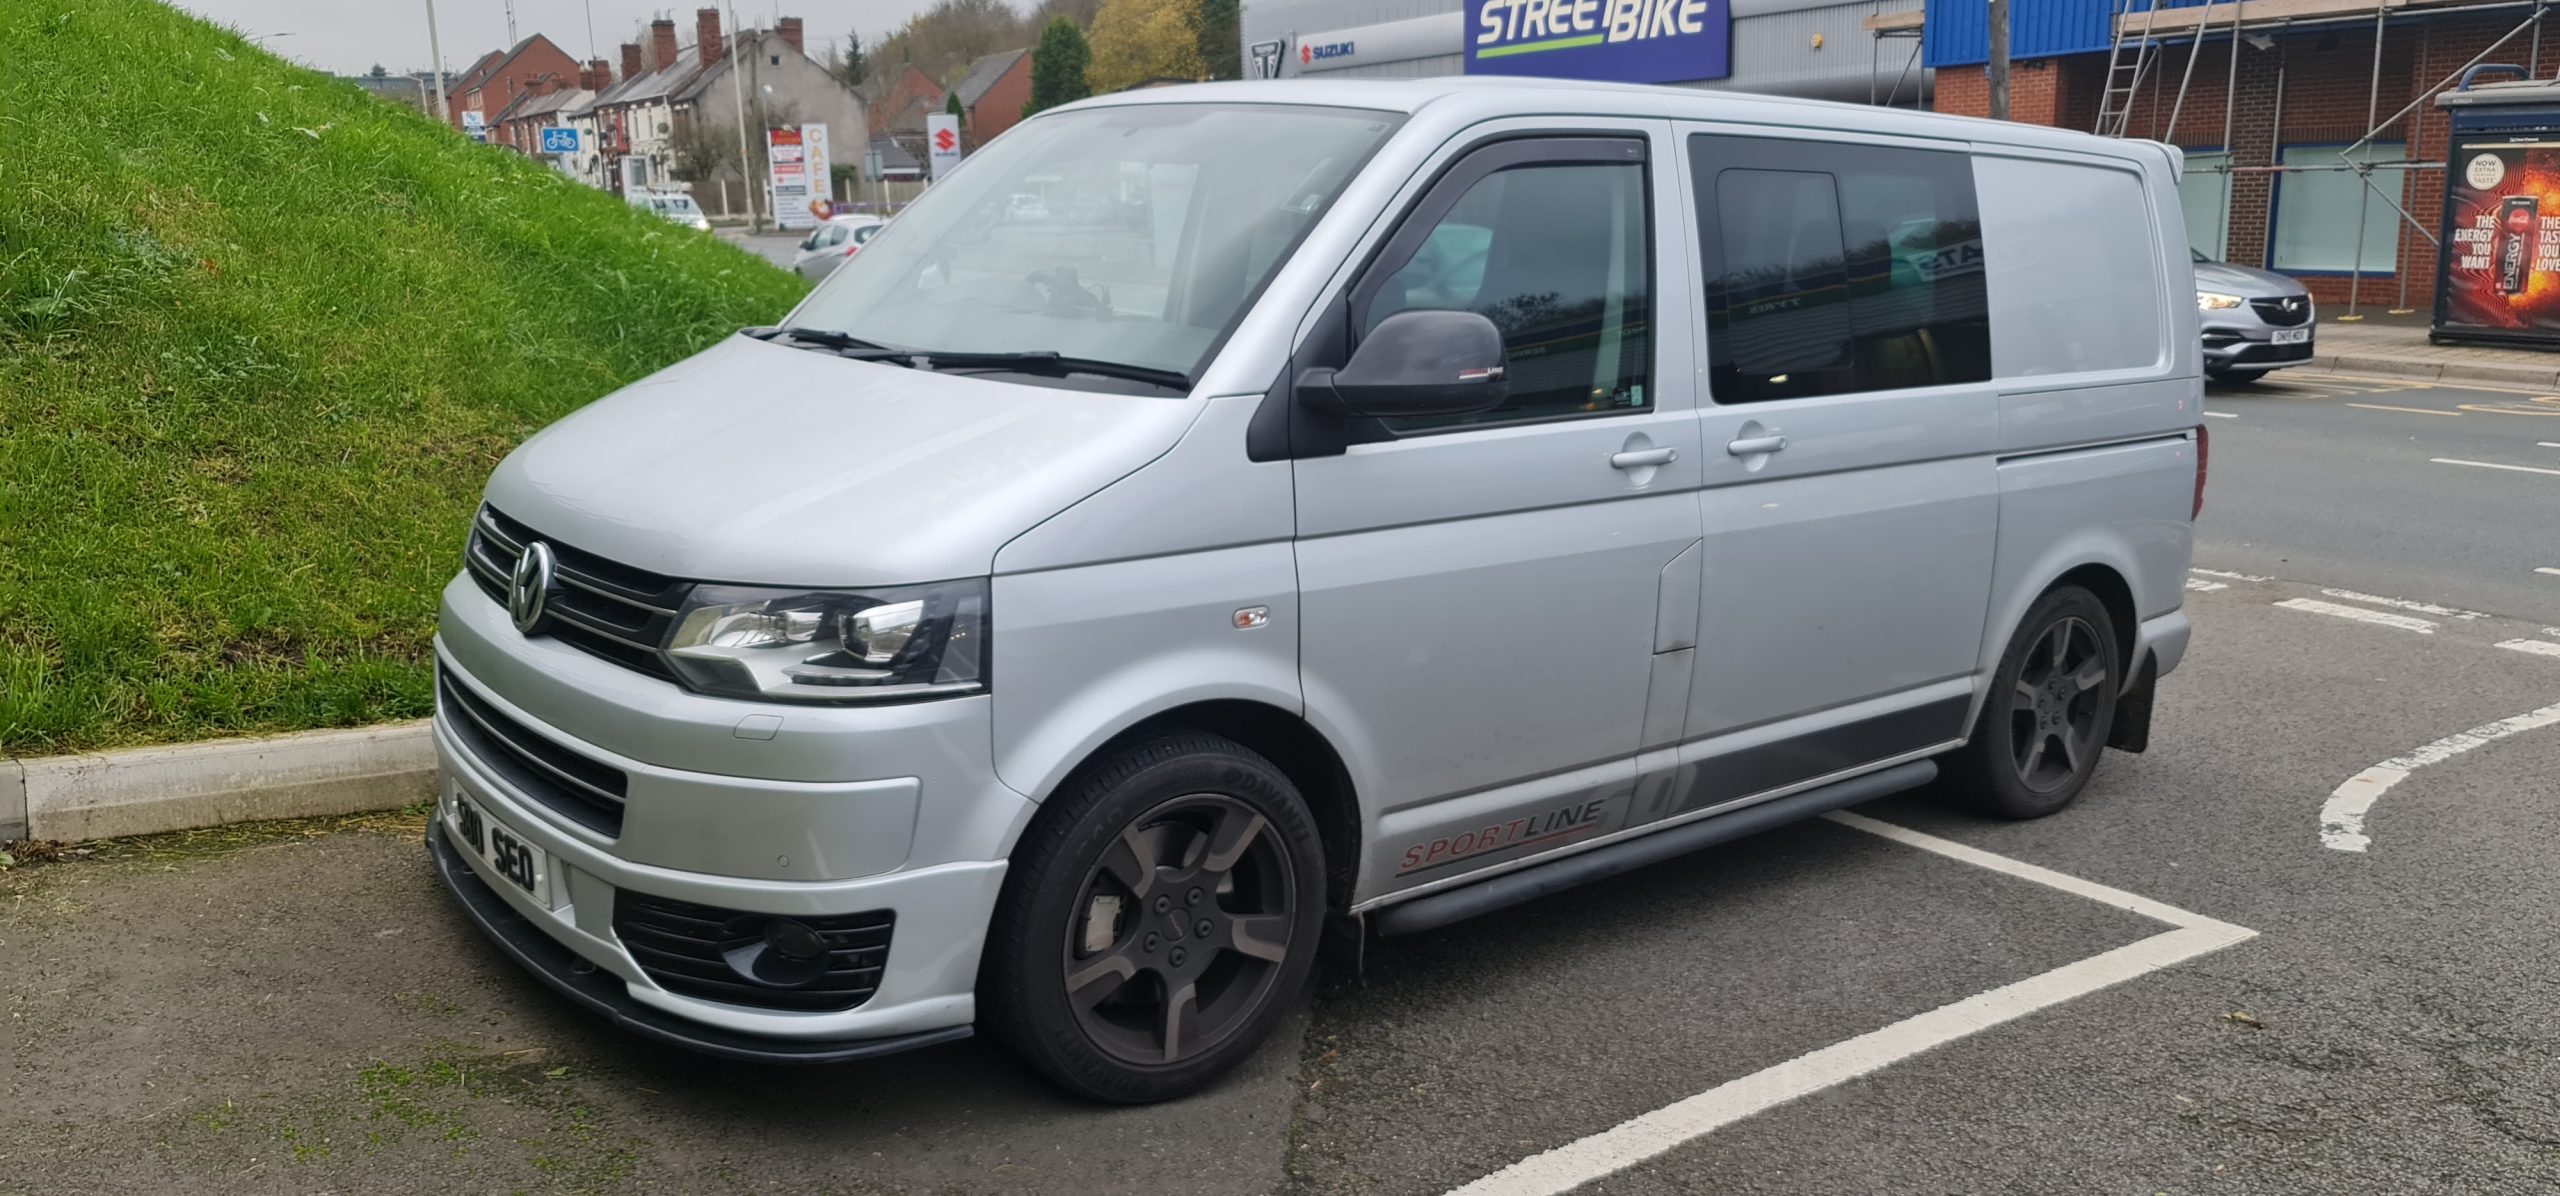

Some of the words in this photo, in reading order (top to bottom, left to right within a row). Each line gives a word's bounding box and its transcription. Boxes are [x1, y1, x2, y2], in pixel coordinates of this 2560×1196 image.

[1313, 41, 1354, 60] SUZUKI
[809, 128, 826, 192] CAFE
[2475, 214, 2495, 228] THE
[2541, 216, 2560, 229] THE
[2454, 229, 2494, 242] ENERGY
[2539, 230, 2560, 243] TAS
[2472, 243, 2492, 255] YOU
[2538, 244, 2559, 258] YOU
[2461, 255, 2491, 269] WANT
[2503, 232, 2521, 290] ENERGY
[1400, 799, 1605, 870] SPORTLINE
[492, 826, 535, 892] SEO
